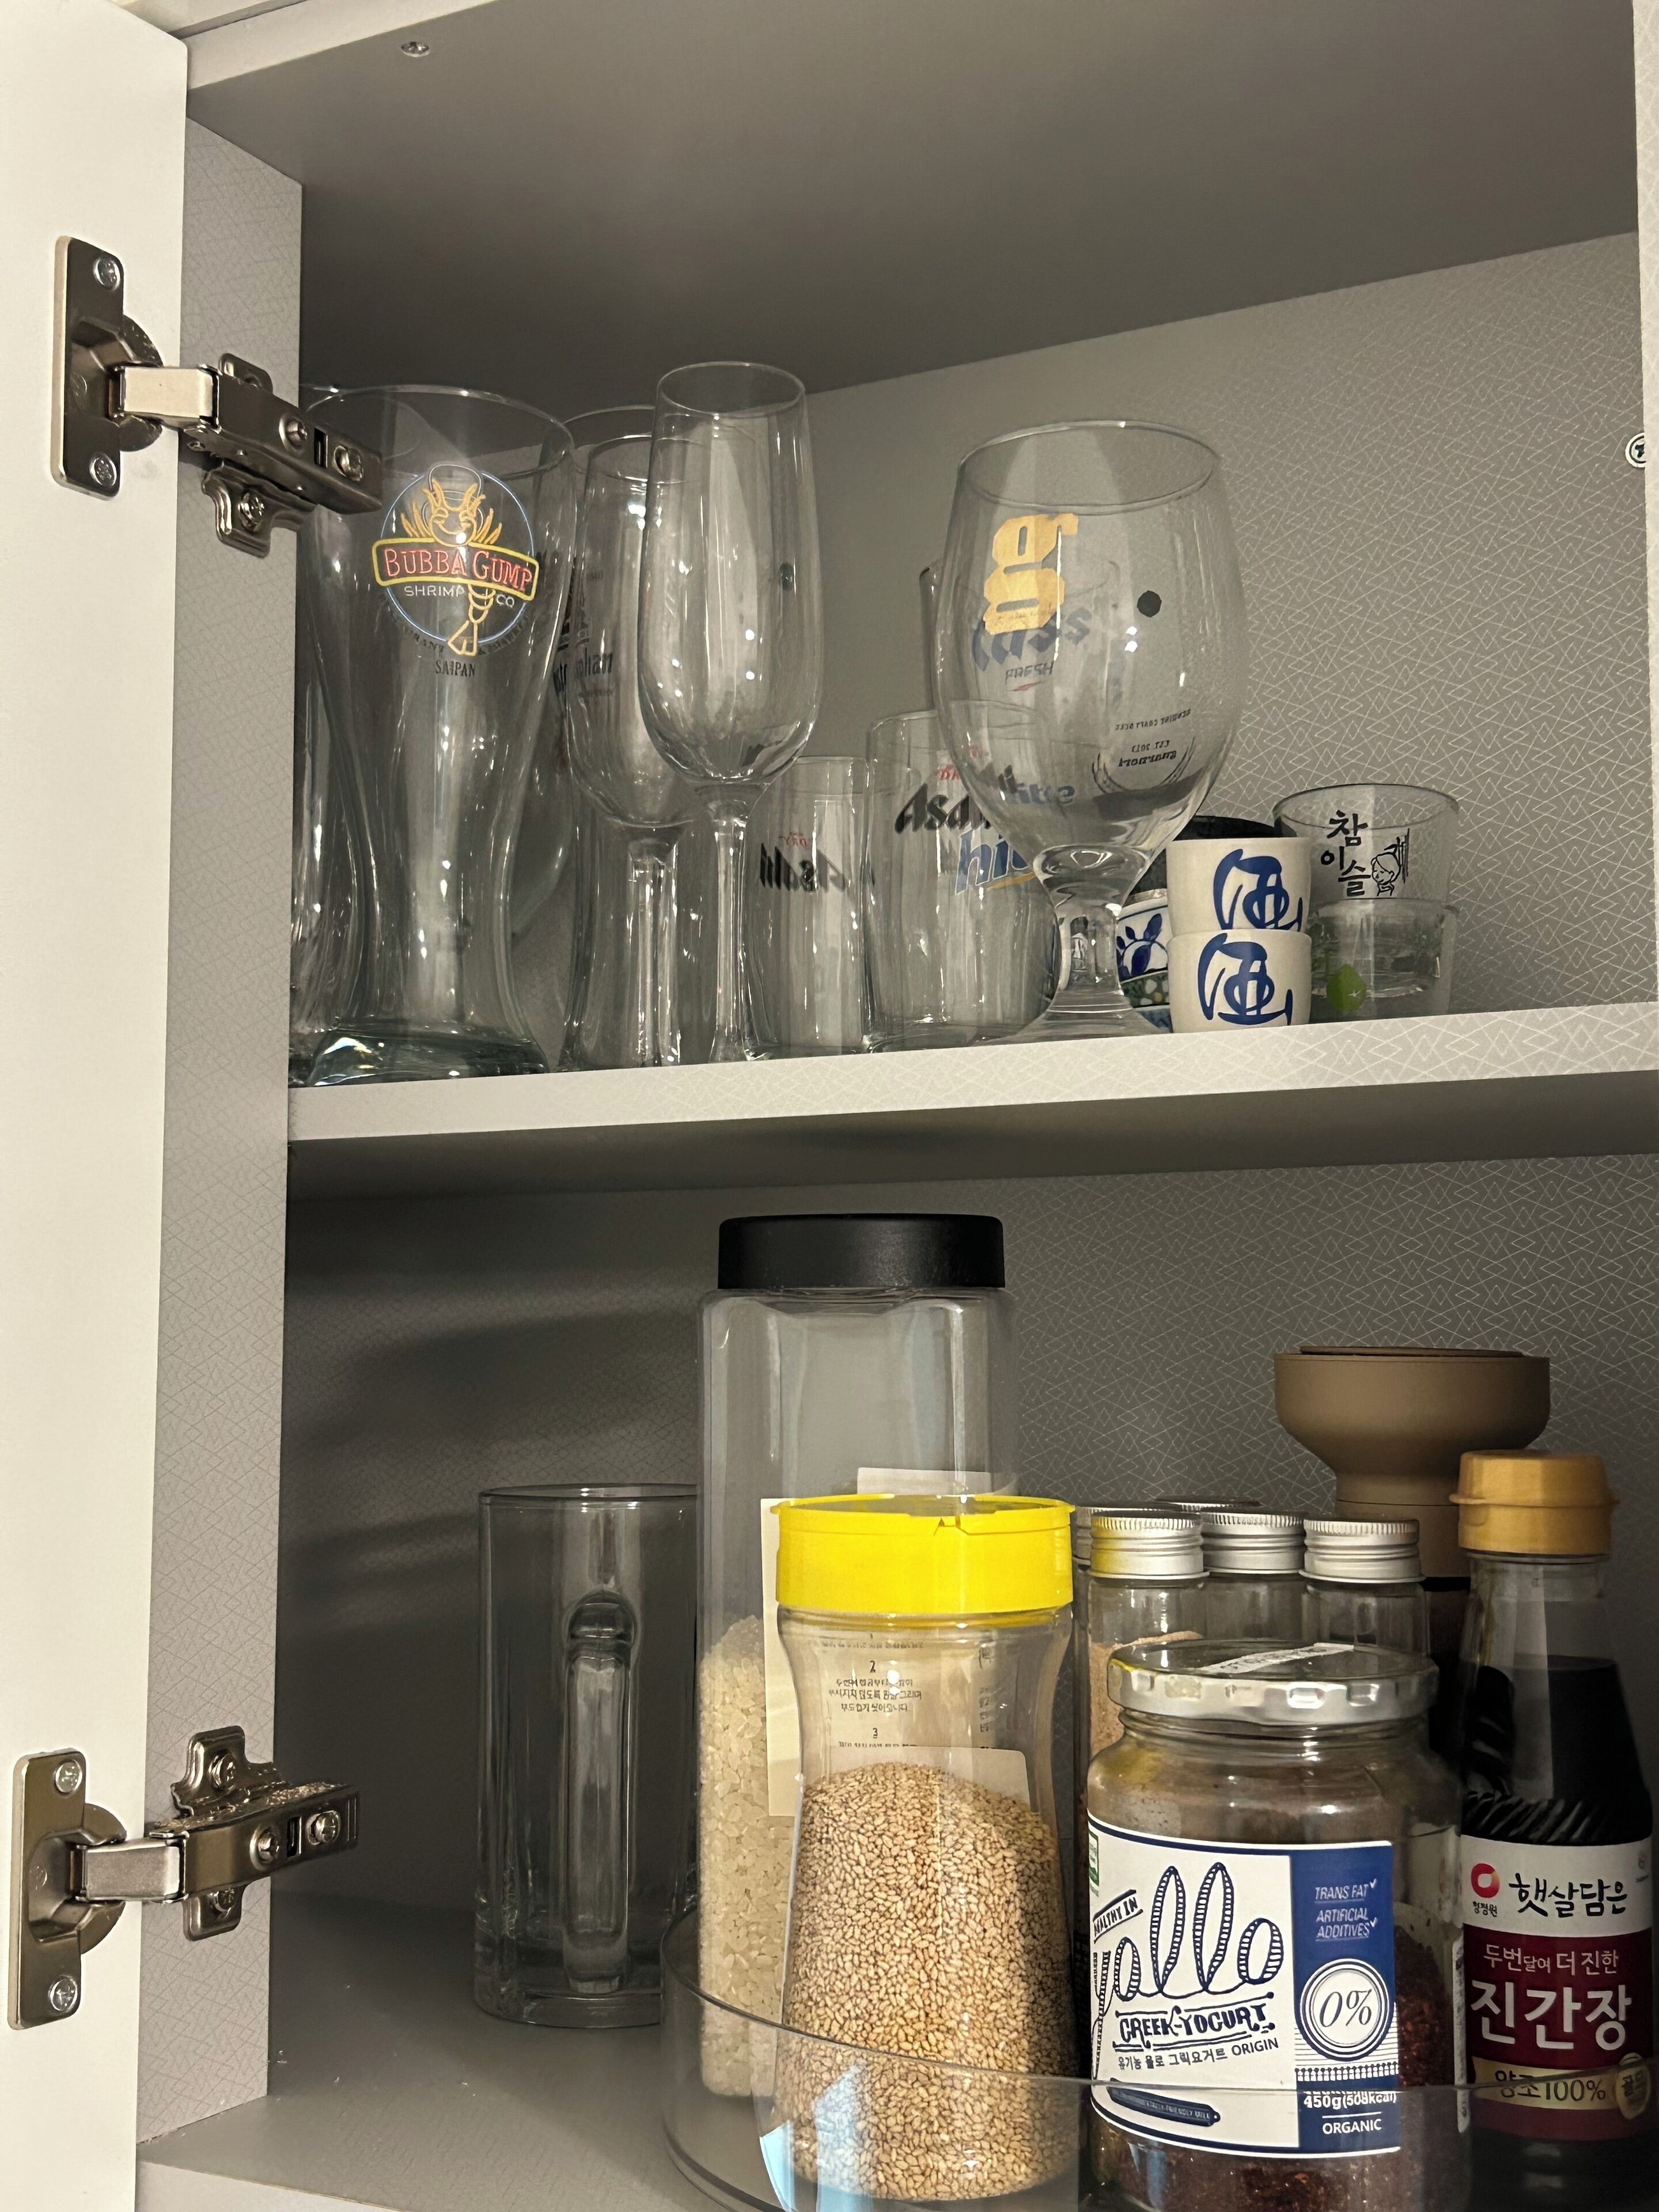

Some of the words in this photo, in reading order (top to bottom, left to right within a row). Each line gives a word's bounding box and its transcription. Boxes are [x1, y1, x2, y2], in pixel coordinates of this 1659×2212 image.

[383, 548, 467, 577] BUBBA
[472, 550, 533, 592] GUMP
[404, 584, 465, 597] SHRIMP
[435, 661, 476, 677] SAIPAN
[1315, 1885, 1350, 1900] TRANS
[1351, 1884, 1369, 1897] FAT
[1509, 1873, 1628, 1918] 햇살담은
[1123, 1897, 1138, 1915] IN
[1316, 1908, 1369, 1922] ARTIFICIAL
[1316, 1922, 1370, 1938] ADDITIVES
[1556, 1951, 1575, 1976] 더
[1581, 1949, 1619, 1975] 진한
[1320, 1988, 1372, 2027] 0%
[1471, 1980, 1633, 2051] 진간장
[1231, 2037, 1279, 2056] ORIGIN
[1322, 2118, 1382, 2135] ORGANIC
